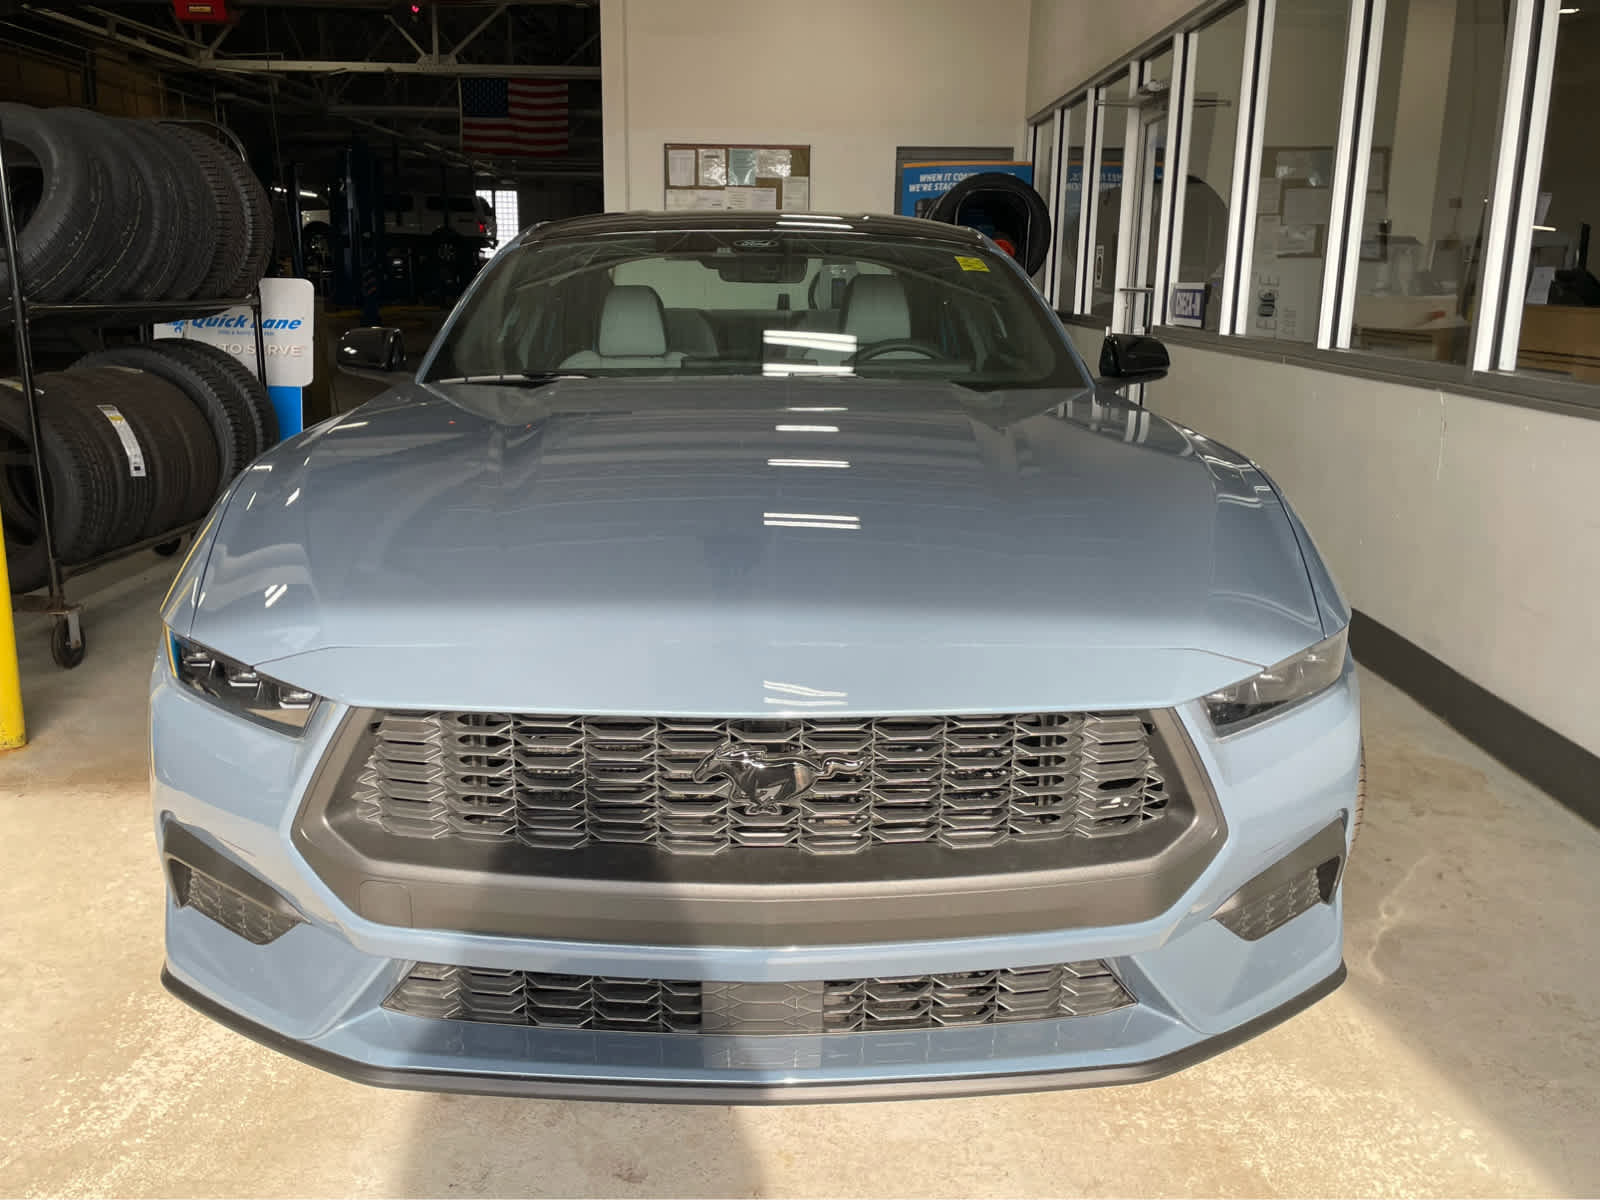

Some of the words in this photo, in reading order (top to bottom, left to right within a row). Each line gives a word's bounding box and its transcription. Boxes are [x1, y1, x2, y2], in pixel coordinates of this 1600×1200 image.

[920, 173, 943, 182] WHEN
[944, 173, 952, 181] IT
[909, 183, 933, 192] WE'RE
[191, 314, 248, 330] Quick
[251, 317, 302, 330] ane
[221, 344, 242, 355] TO
[247, 344, 303, 357] SRVE
